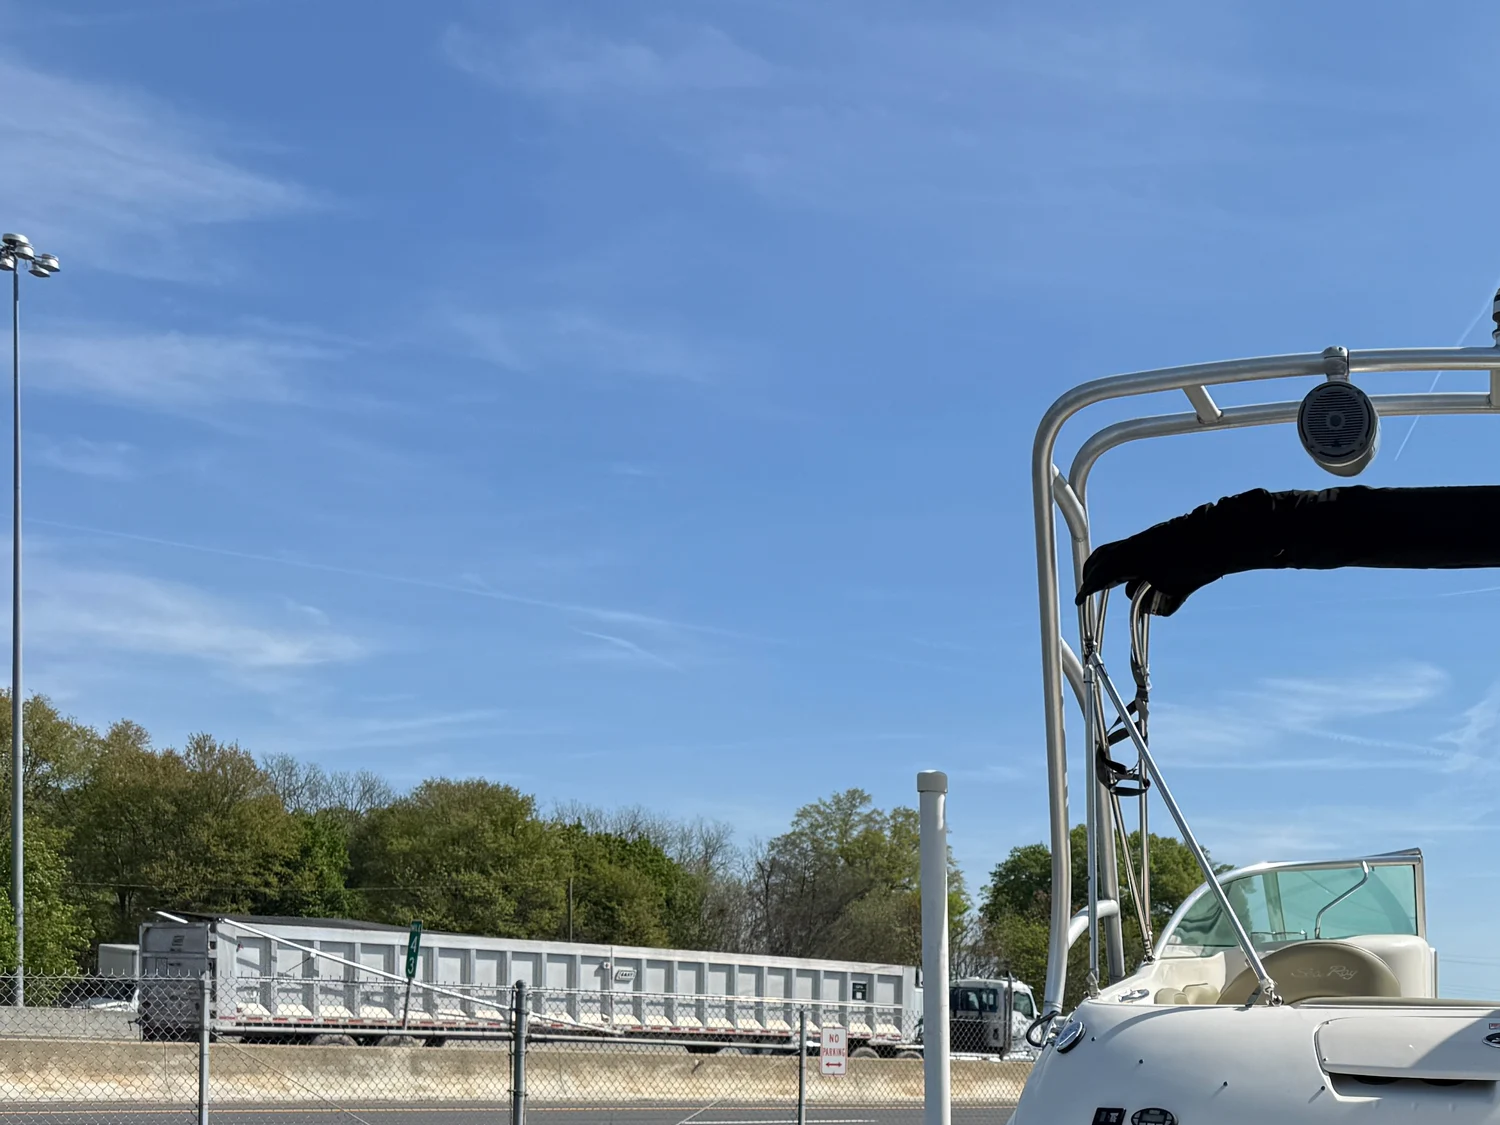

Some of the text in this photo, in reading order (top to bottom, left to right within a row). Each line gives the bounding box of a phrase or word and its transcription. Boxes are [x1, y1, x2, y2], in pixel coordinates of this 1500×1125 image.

[1327, 965, 1358, 980] Ray
[829, 1034, 840, 1043] NO
[823, 1048, 845, 1057] PARKING
